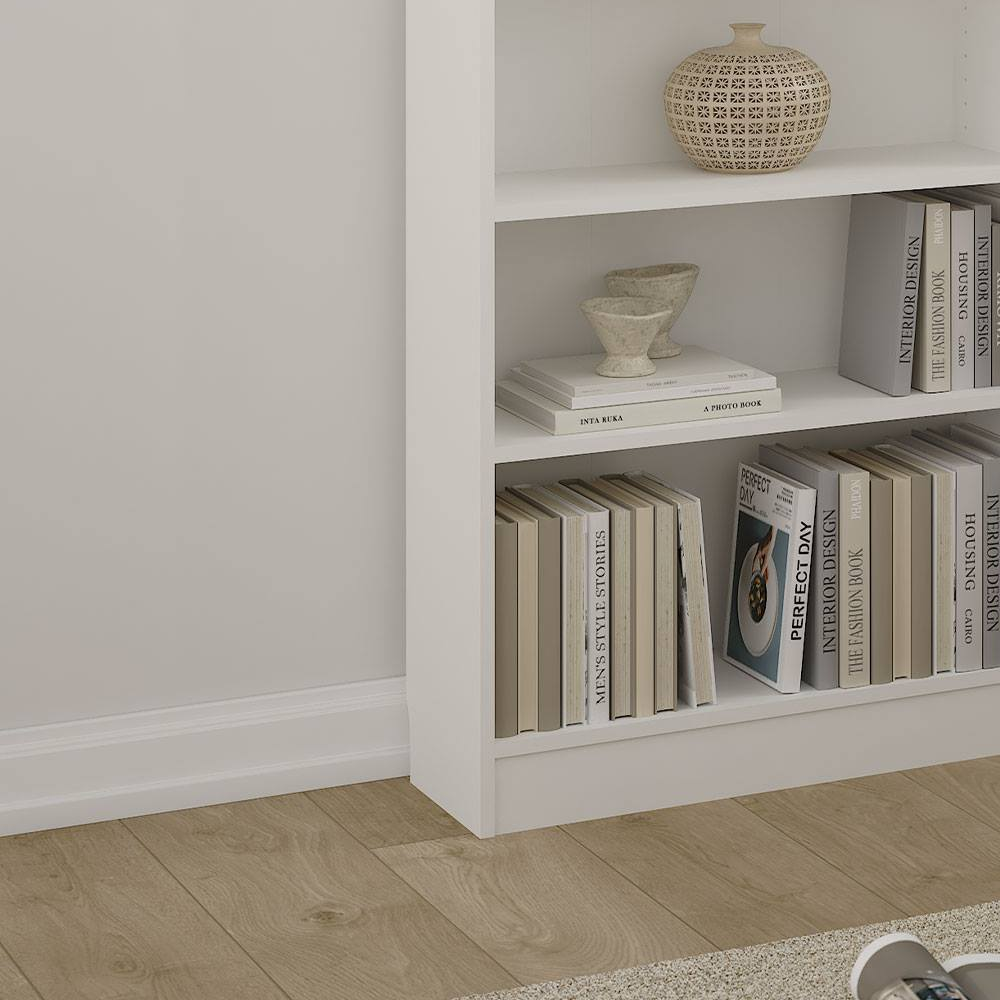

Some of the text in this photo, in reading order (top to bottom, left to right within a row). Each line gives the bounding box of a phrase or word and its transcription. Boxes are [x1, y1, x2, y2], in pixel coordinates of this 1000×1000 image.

[899, 236, 920, 363] INTERIOR DESIGN
[932, 270, 945, 382] THE FASHION BOOK
[958, 252, 968, 367] HOUSING CAIRO
[978, 235, 988, 357] INTERIOR DESIGN
[580, 415, 624, 425] INTA RUKA
[711, 402, 739, 412] PHOTO
[740, 399, 762, 408] BOOK
[740, 486, 754, 504] DAY
[741, 467, 771, 494] PERFECT
[595, 530, 606, 704] MEN'S STYLE STORIES
[791, 521, 812, 640] PERFECT DAY
[823, 510, 836, 654] INTERIOR DESIGN
[849, 548, 863, 677] THE FASHION BOOK
[964, 513, 975, 644] HOUSING CAIRO
[987, 494, 999, 632] INTERIOR DESIGN
